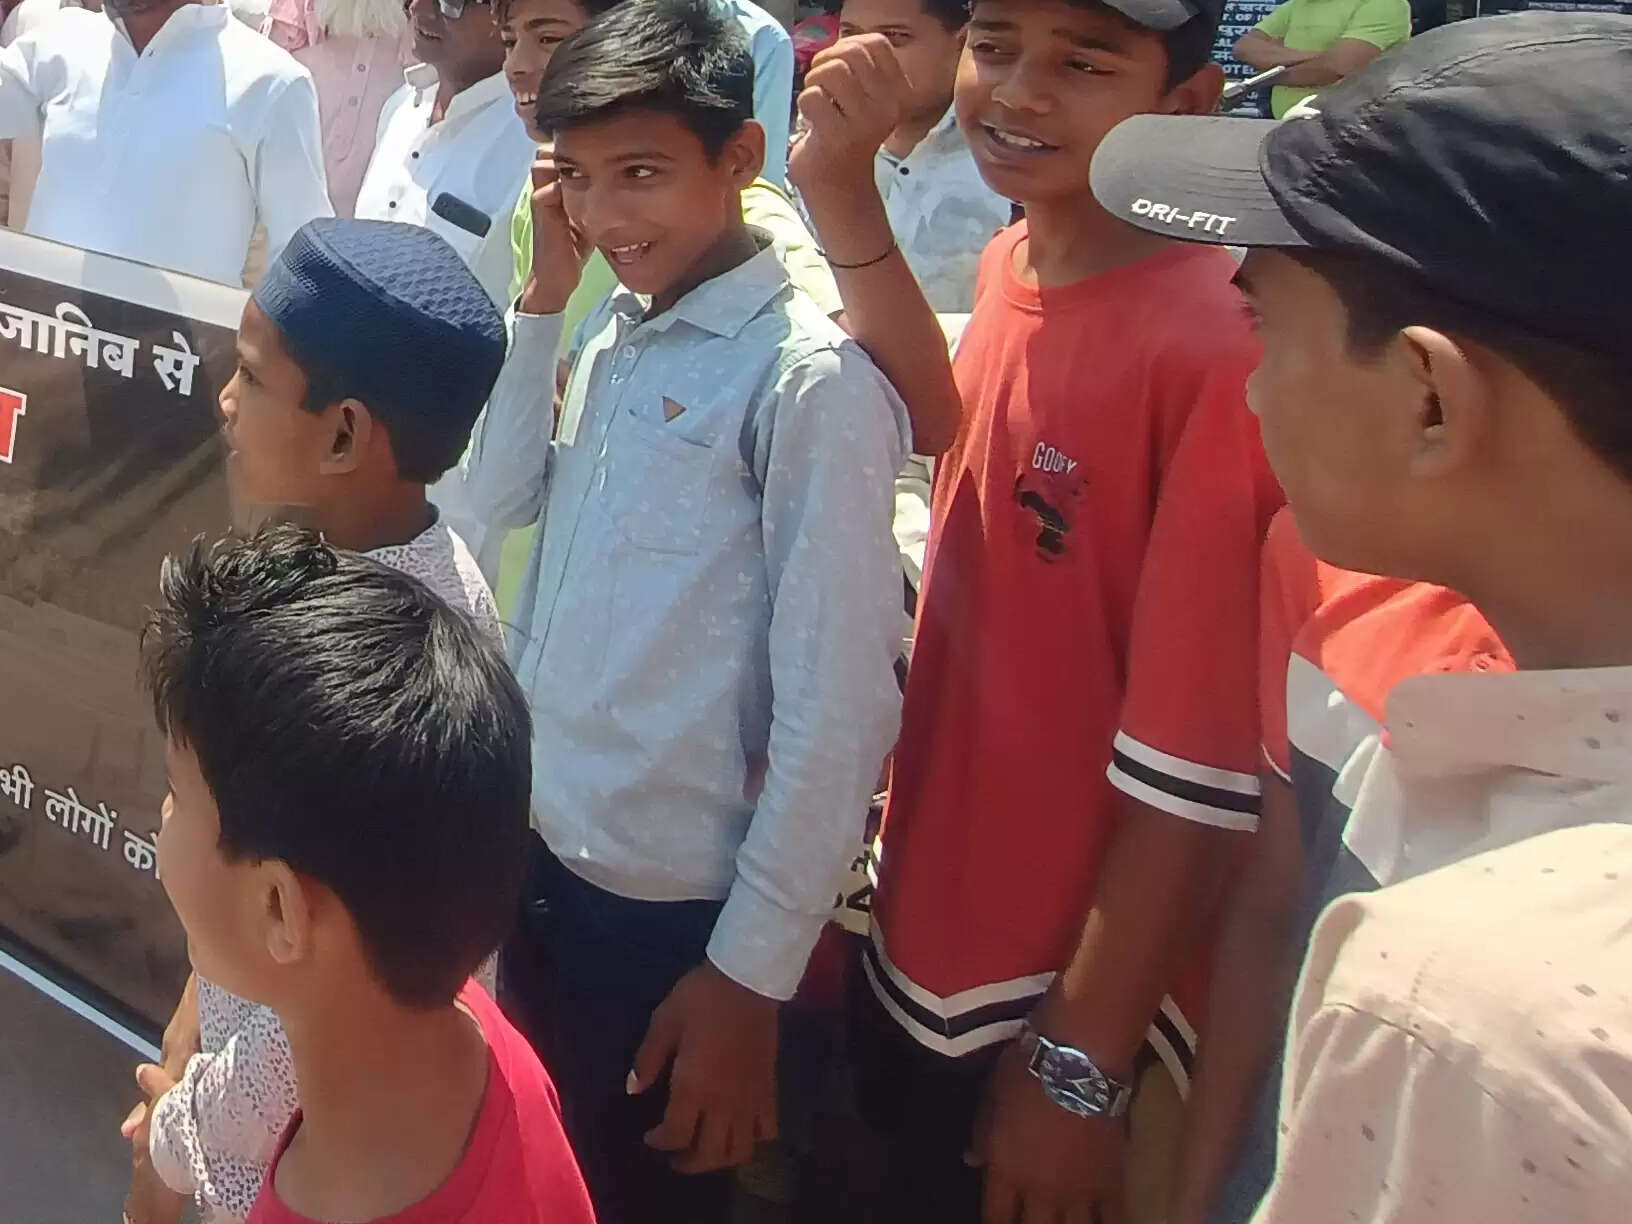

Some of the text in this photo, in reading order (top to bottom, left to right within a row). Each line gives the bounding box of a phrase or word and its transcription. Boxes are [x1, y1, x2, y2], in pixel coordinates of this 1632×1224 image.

[1130, 197, 1238, 235] DRI-FIT
[152, 331, 200, 396] से
[44, 787, 119, 851] लोगों
